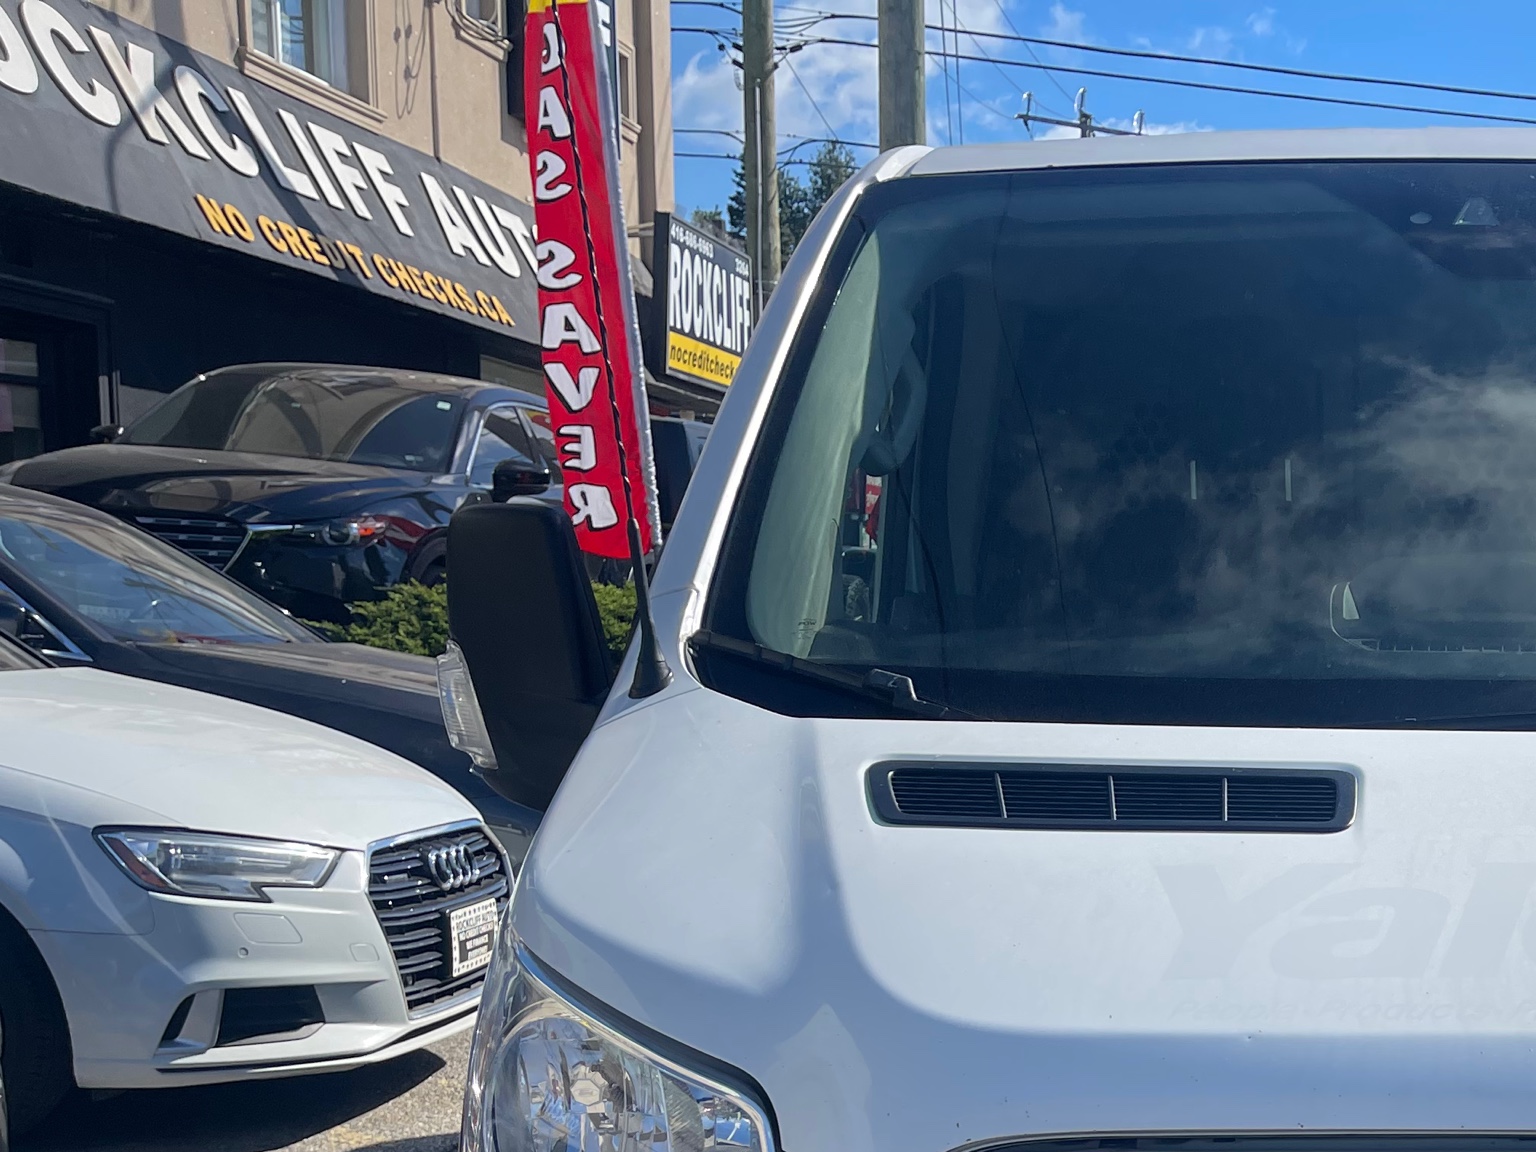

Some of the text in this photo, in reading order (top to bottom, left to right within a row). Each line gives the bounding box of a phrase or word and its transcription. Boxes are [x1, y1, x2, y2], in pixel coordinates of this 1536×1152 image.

[194, 192, 516, 327] NO CREDIT CHECKS.CA
[418, 171, 539, 280] AUT
[669, 242, 751, 353] ROCKCLIFF
